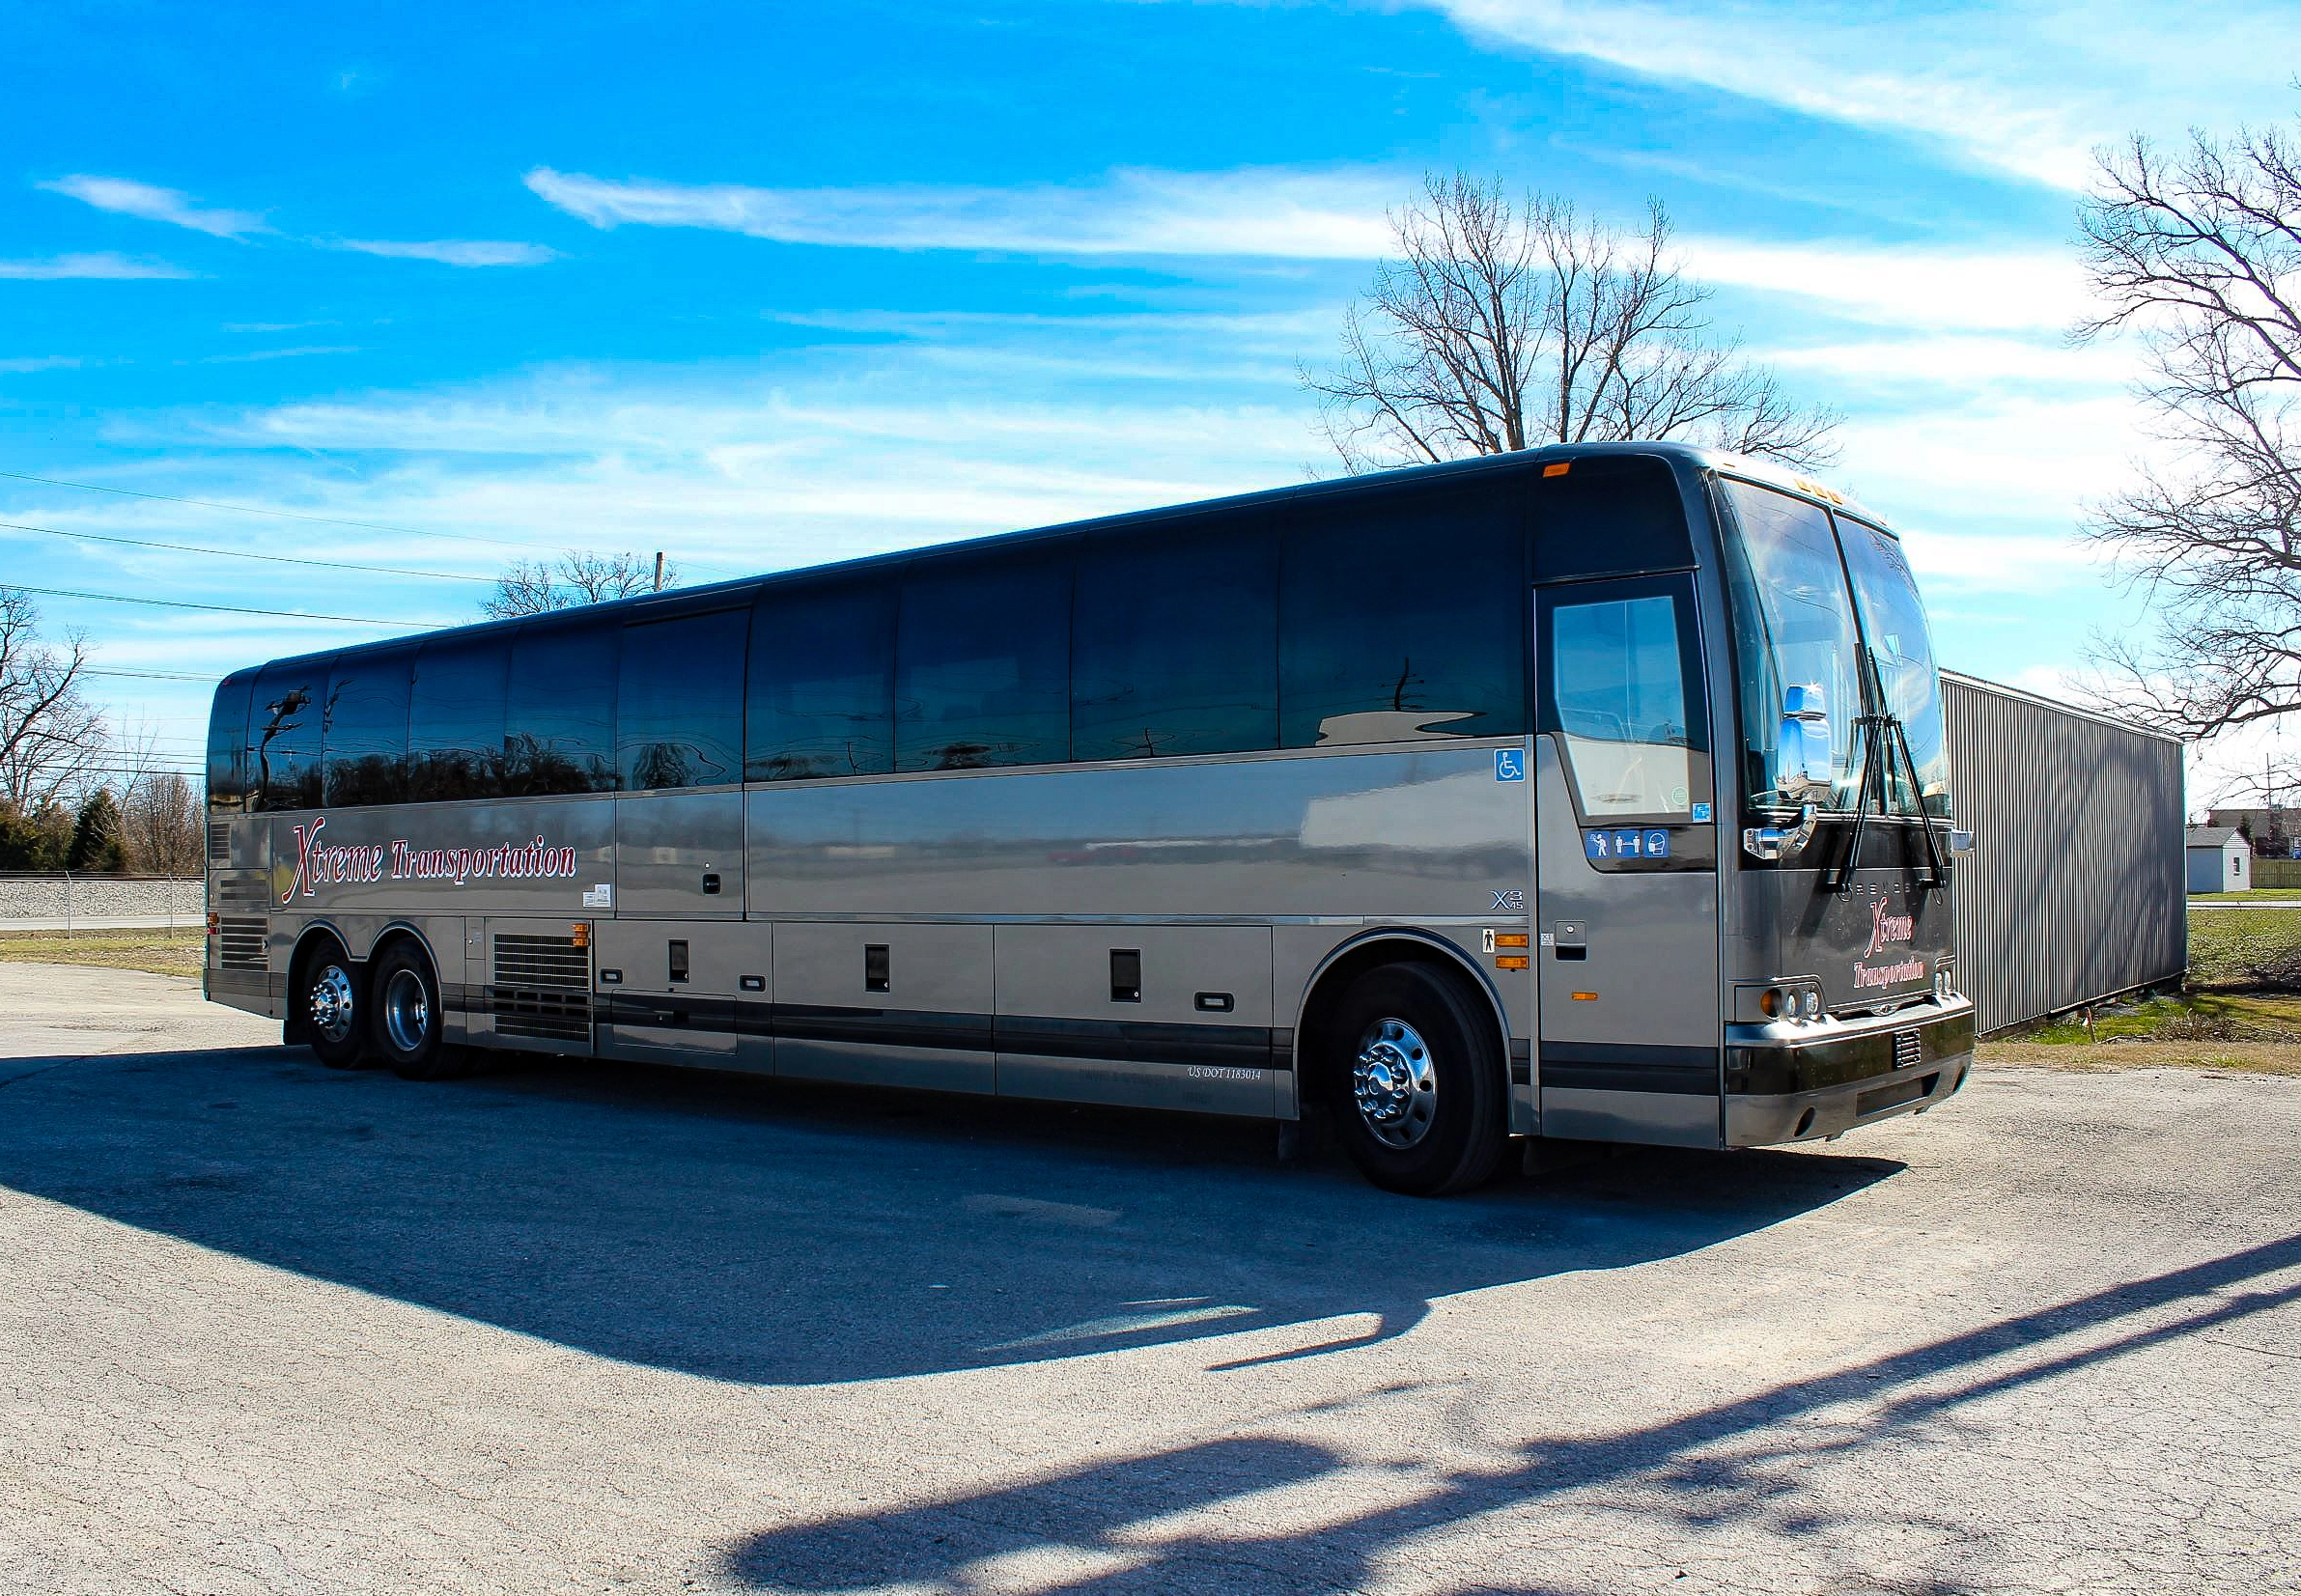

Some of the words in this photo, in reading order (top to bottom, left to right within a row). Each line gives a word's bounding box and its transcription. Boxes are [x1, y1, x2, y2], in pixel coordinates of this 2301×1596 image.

[281, 816, 383, 905] Xtreme
[390, 834, 577, 885] Transportation
[1863, 896, 1915, 959] Xtreme
[1853, 955, 1925, 990] Transportation
[1187, 1065, 1201, 1078] US
[1202, 1066, 1225, 1079] DOT
[1225, 1069, 1261, 1080] 1183014
